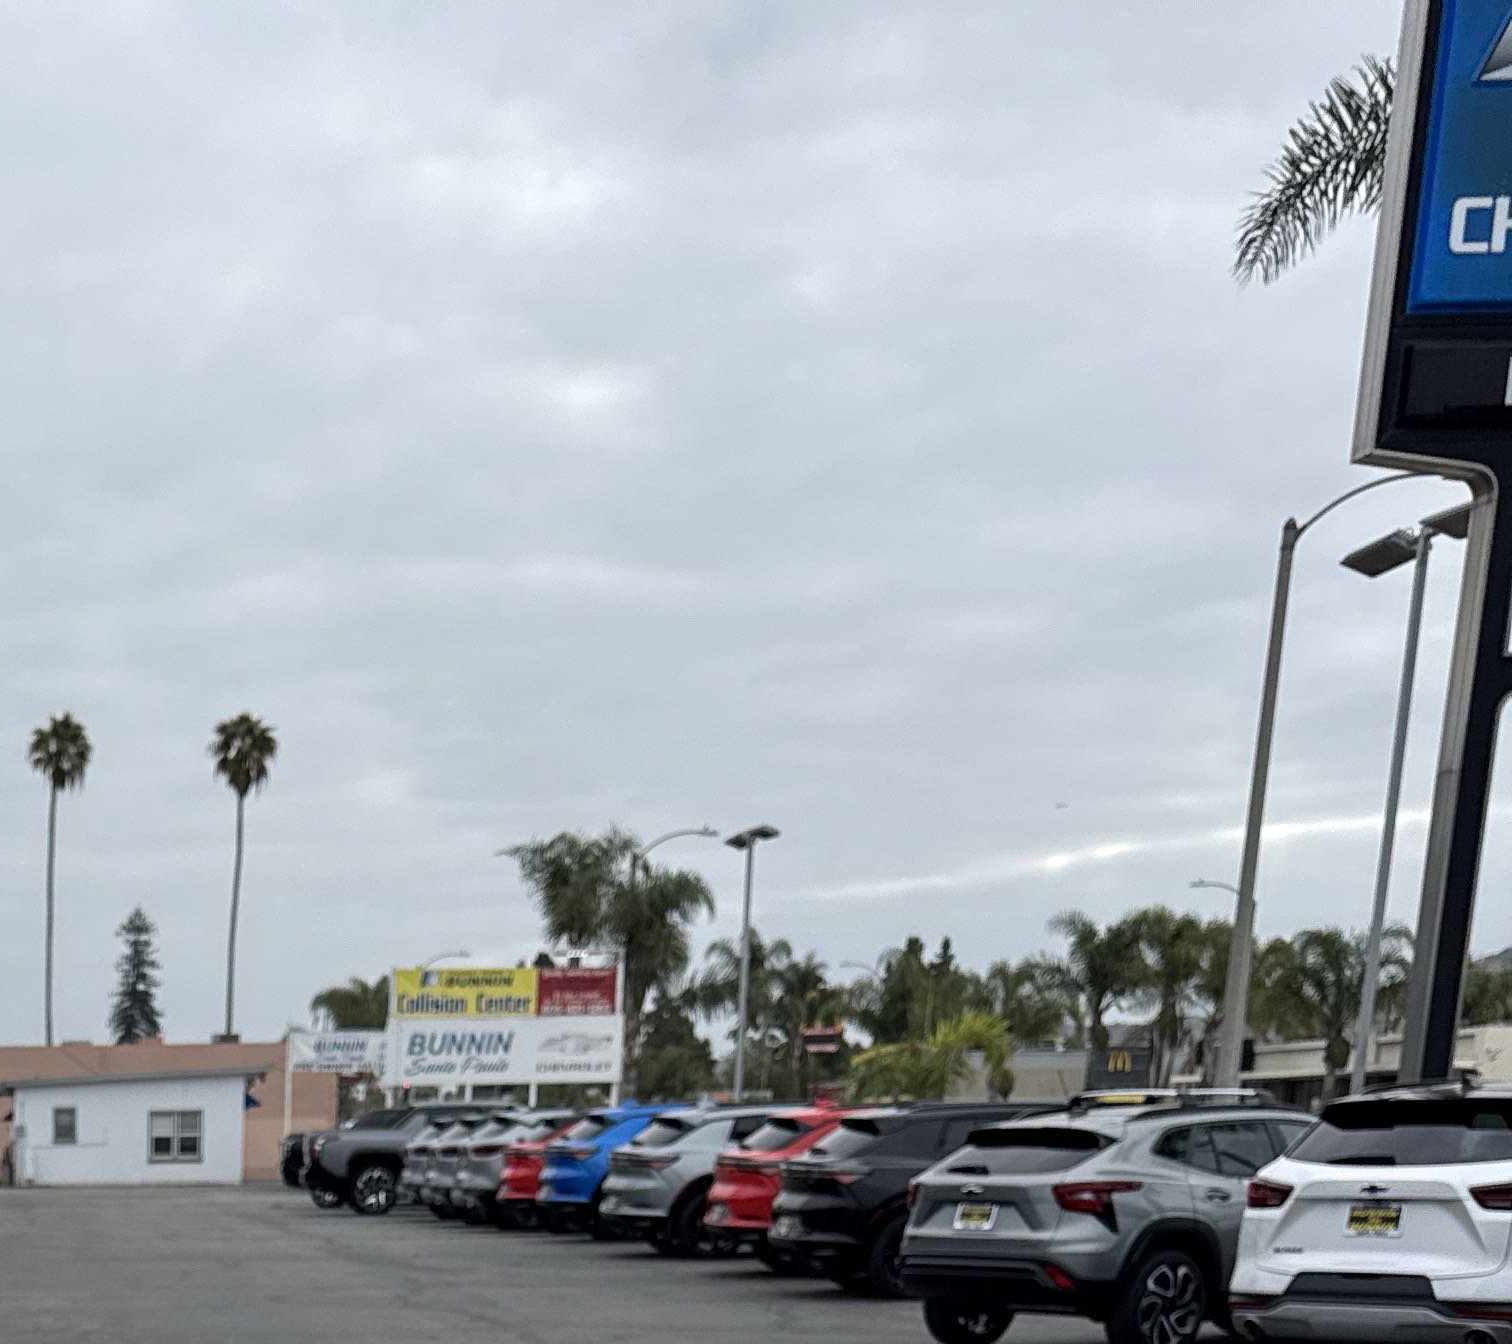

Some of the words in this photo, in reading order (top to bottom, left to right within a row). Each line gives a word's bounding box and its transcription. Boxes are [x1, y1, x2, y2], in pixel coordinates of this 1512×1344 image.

[396, 993, 468, 1014] Collision
[475, 992, 531, 1013] Center
[406, 1031, 515, 1056] BUNNIN
